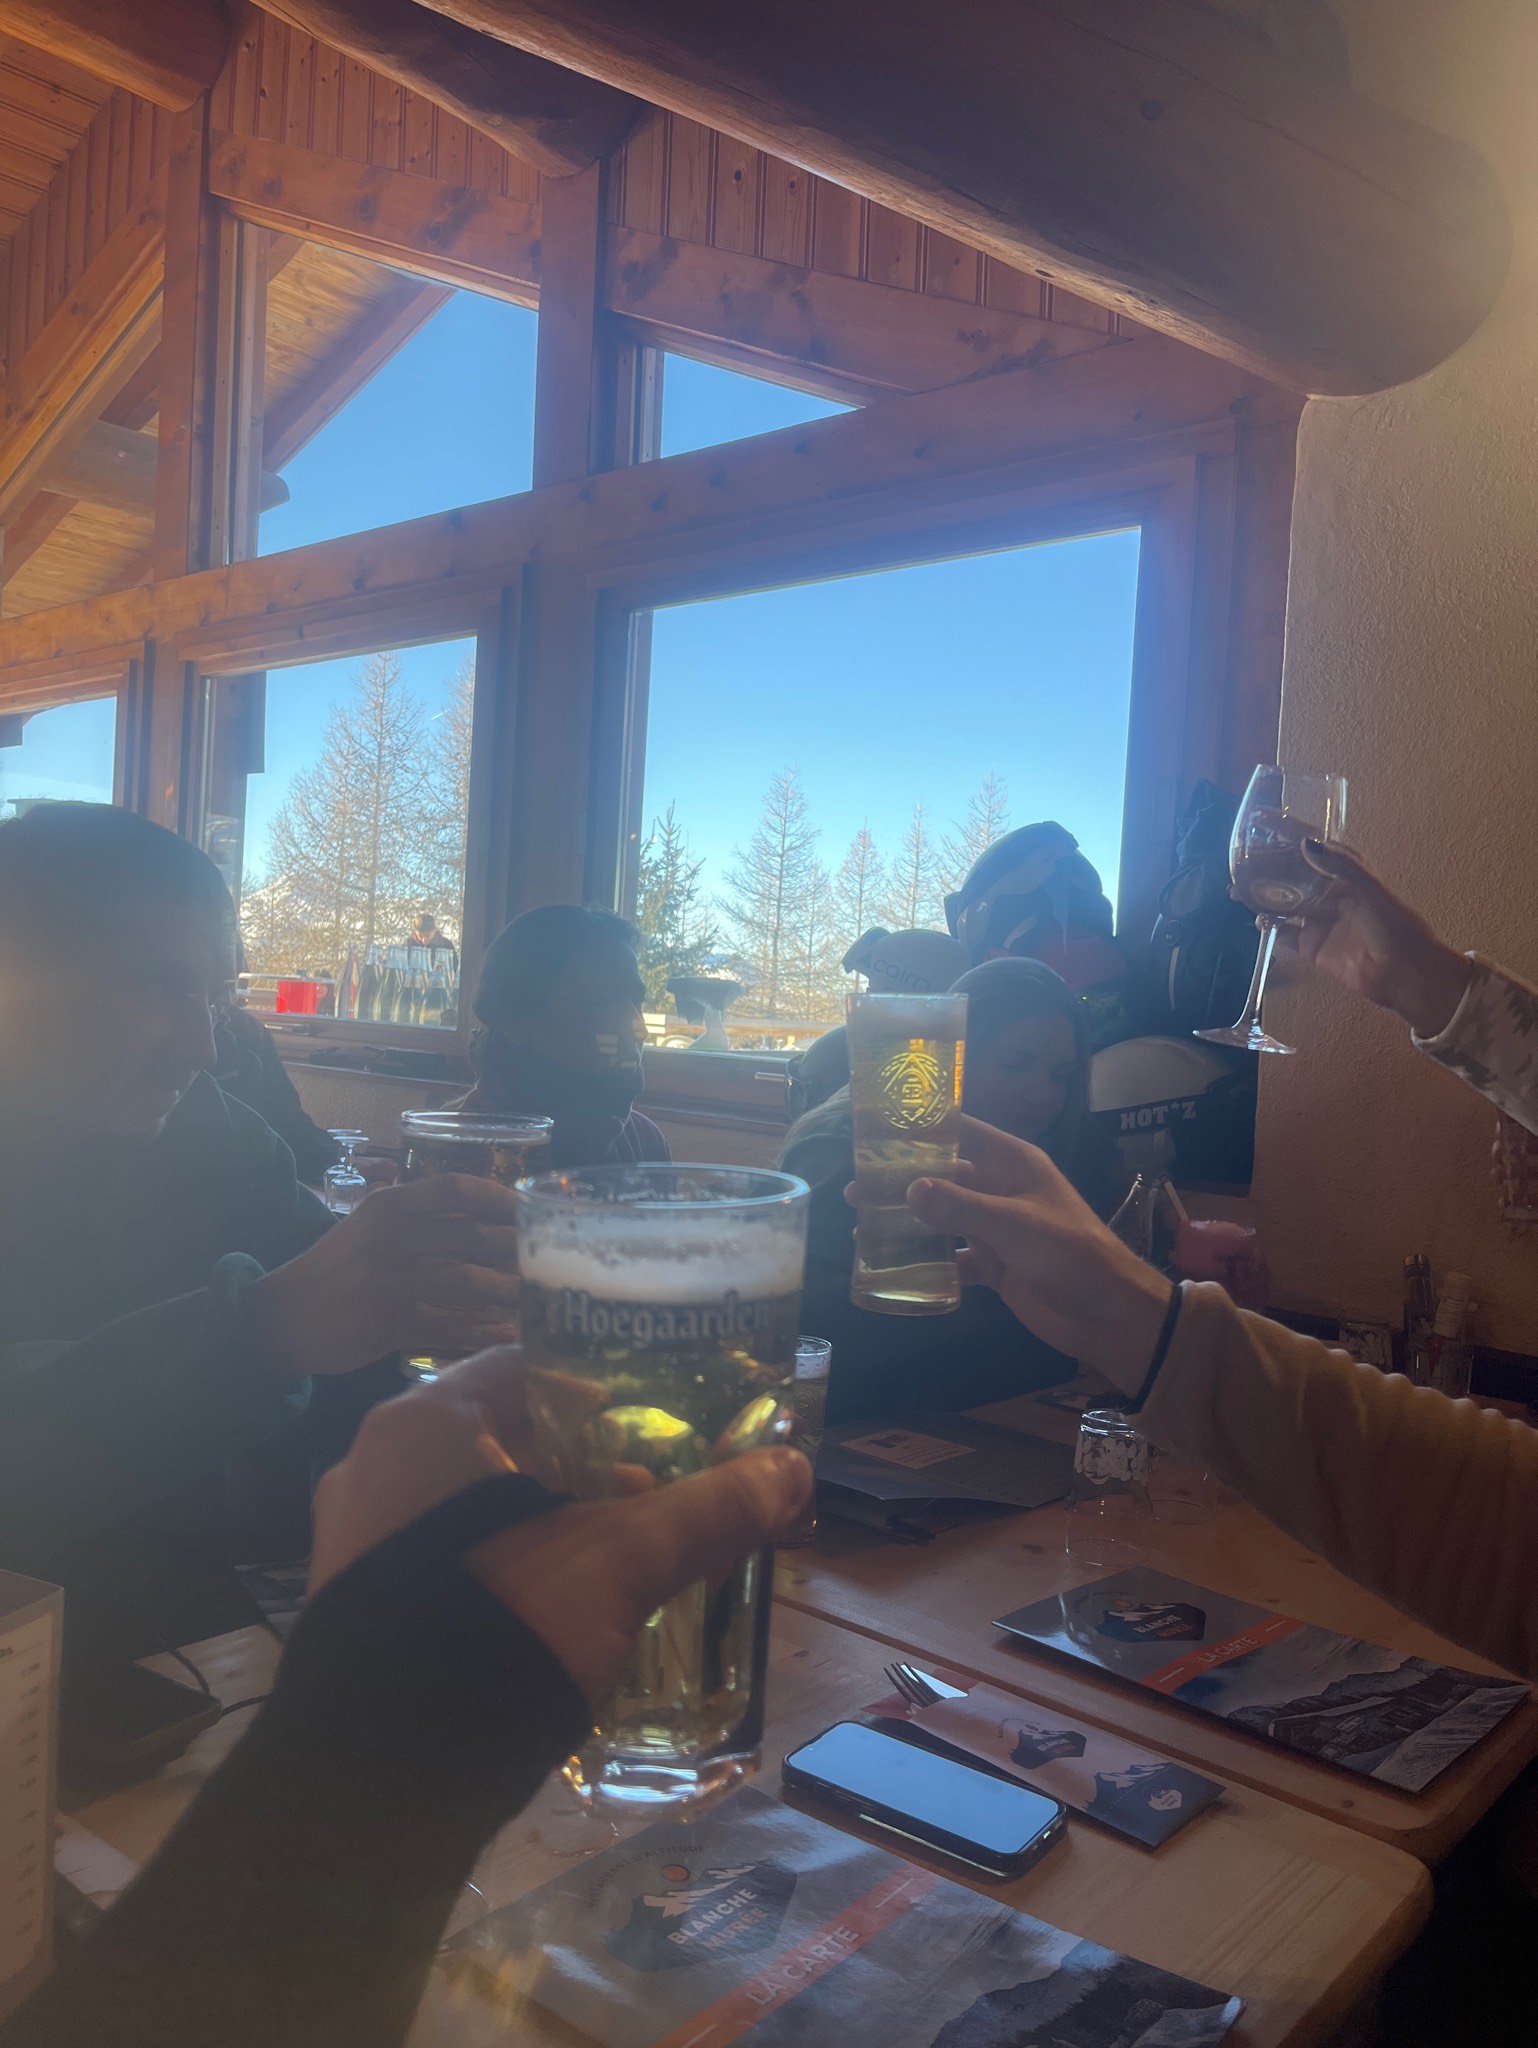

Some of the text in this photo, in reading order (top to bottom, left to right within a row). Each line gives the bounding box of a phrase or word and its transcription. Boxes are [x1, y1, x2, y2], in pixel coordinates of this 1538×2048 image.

[872, 958, 931, 992] cairn
[546, 1287, 770, 1350] Hoegaarden
[1132, 1614, 1182, 1633] BLANCHE
[1197, 1636, 1258, 1663] LA CARTE
[667, 1888, 758, 1945] BLANCHE
[747, 1925, 861, 2006] LA CARTE
